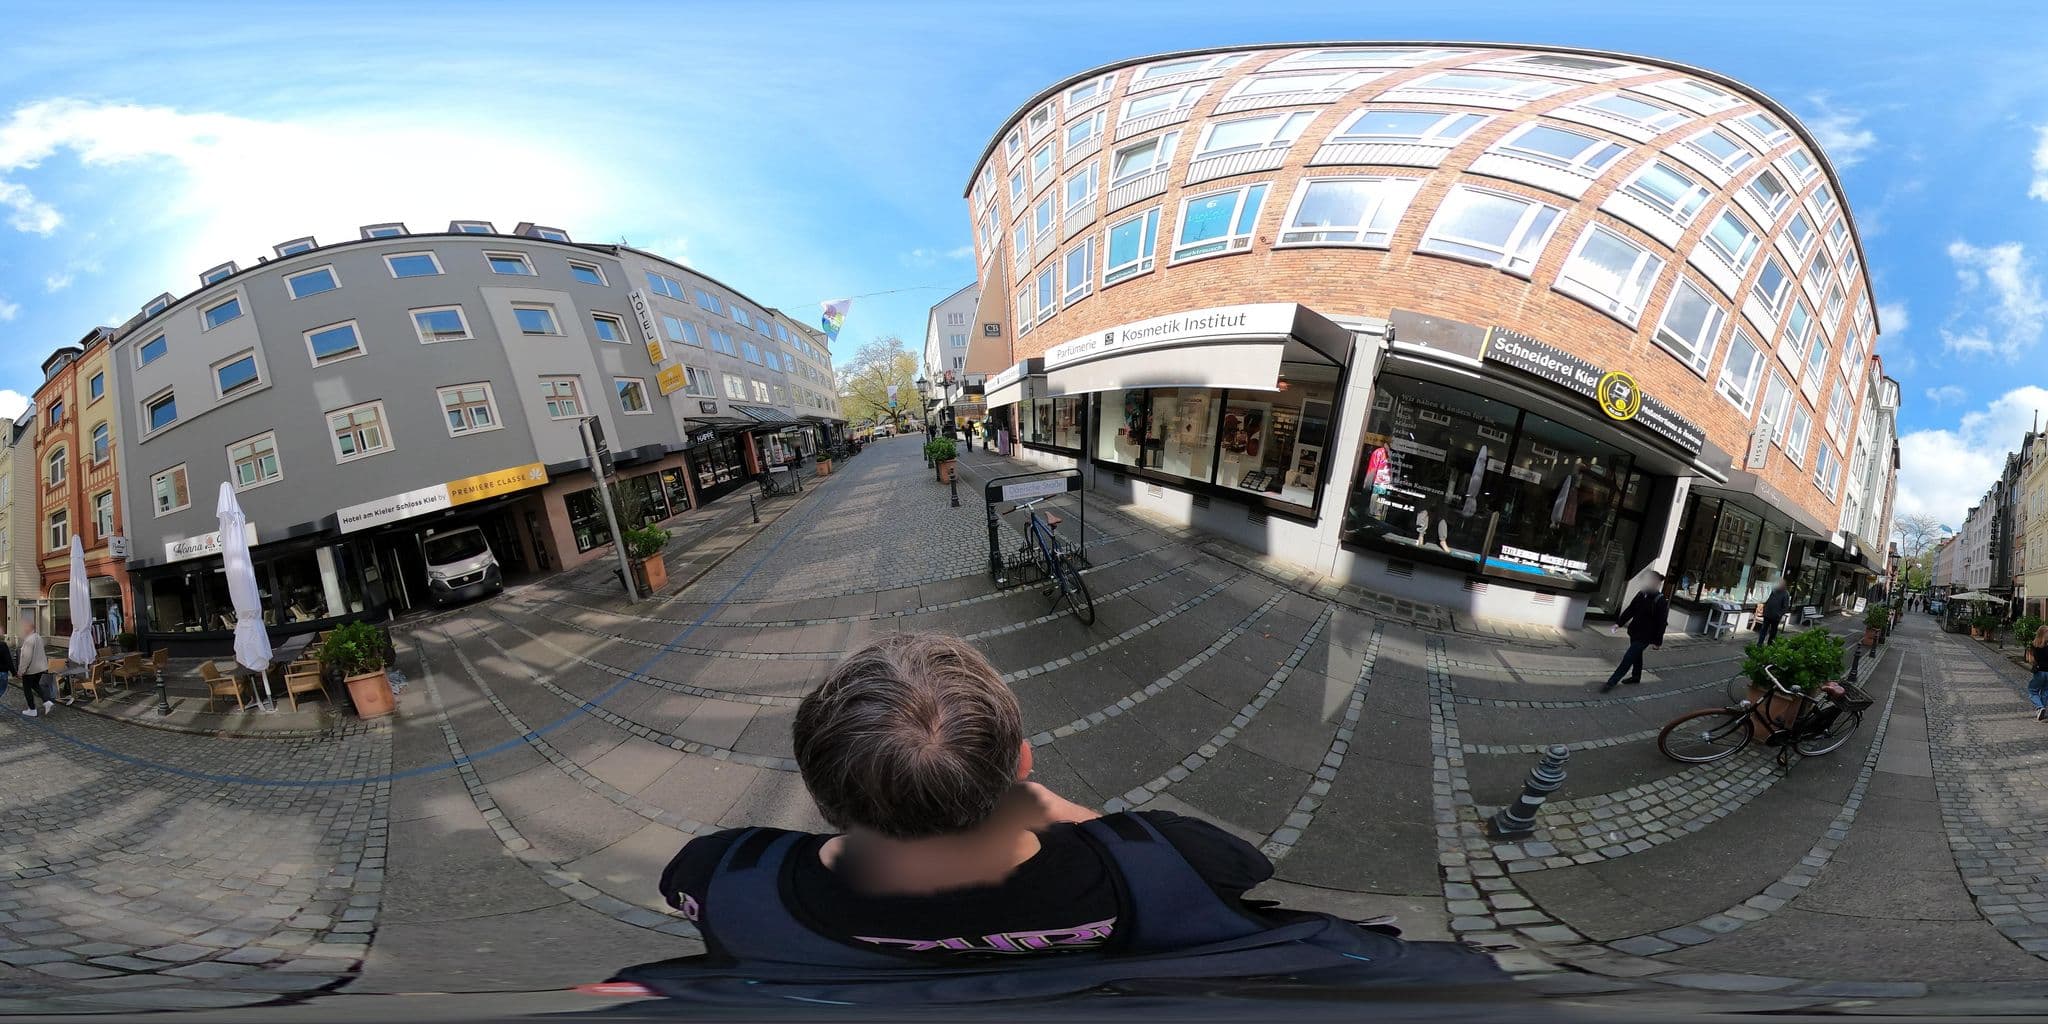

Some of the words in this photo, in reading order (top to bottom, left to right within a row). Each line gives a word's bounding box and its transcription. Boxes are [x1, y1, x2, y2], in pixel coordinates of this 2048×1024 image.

[632, 292, 654, 340] HOTEL
[986, 324, 999, 332] CB
[1057, 339, 1096, 359] Parfümerie
[1122, 319, 1180, 343] Kosmetik
[1184, 313, 1247, 331] Institut
[1494, 337, 1574, 377] Schneiderei
[1574, 368, 1599, 388] Kiel
[1754, 428, 1767, 463] KLASSIK
[452, 482, 495, 496] PREMIERE
[497, 474, 526, 486] CLASSE
[343, 513, 362, 525] Hotel
[363, 511, 374, 520] am
[374, 506, 395, 517] Kieler
[396, 499, 423, 511] Schloss
[423, 495, 438, 506] Kiel
[438, 494, 446, 503] by
